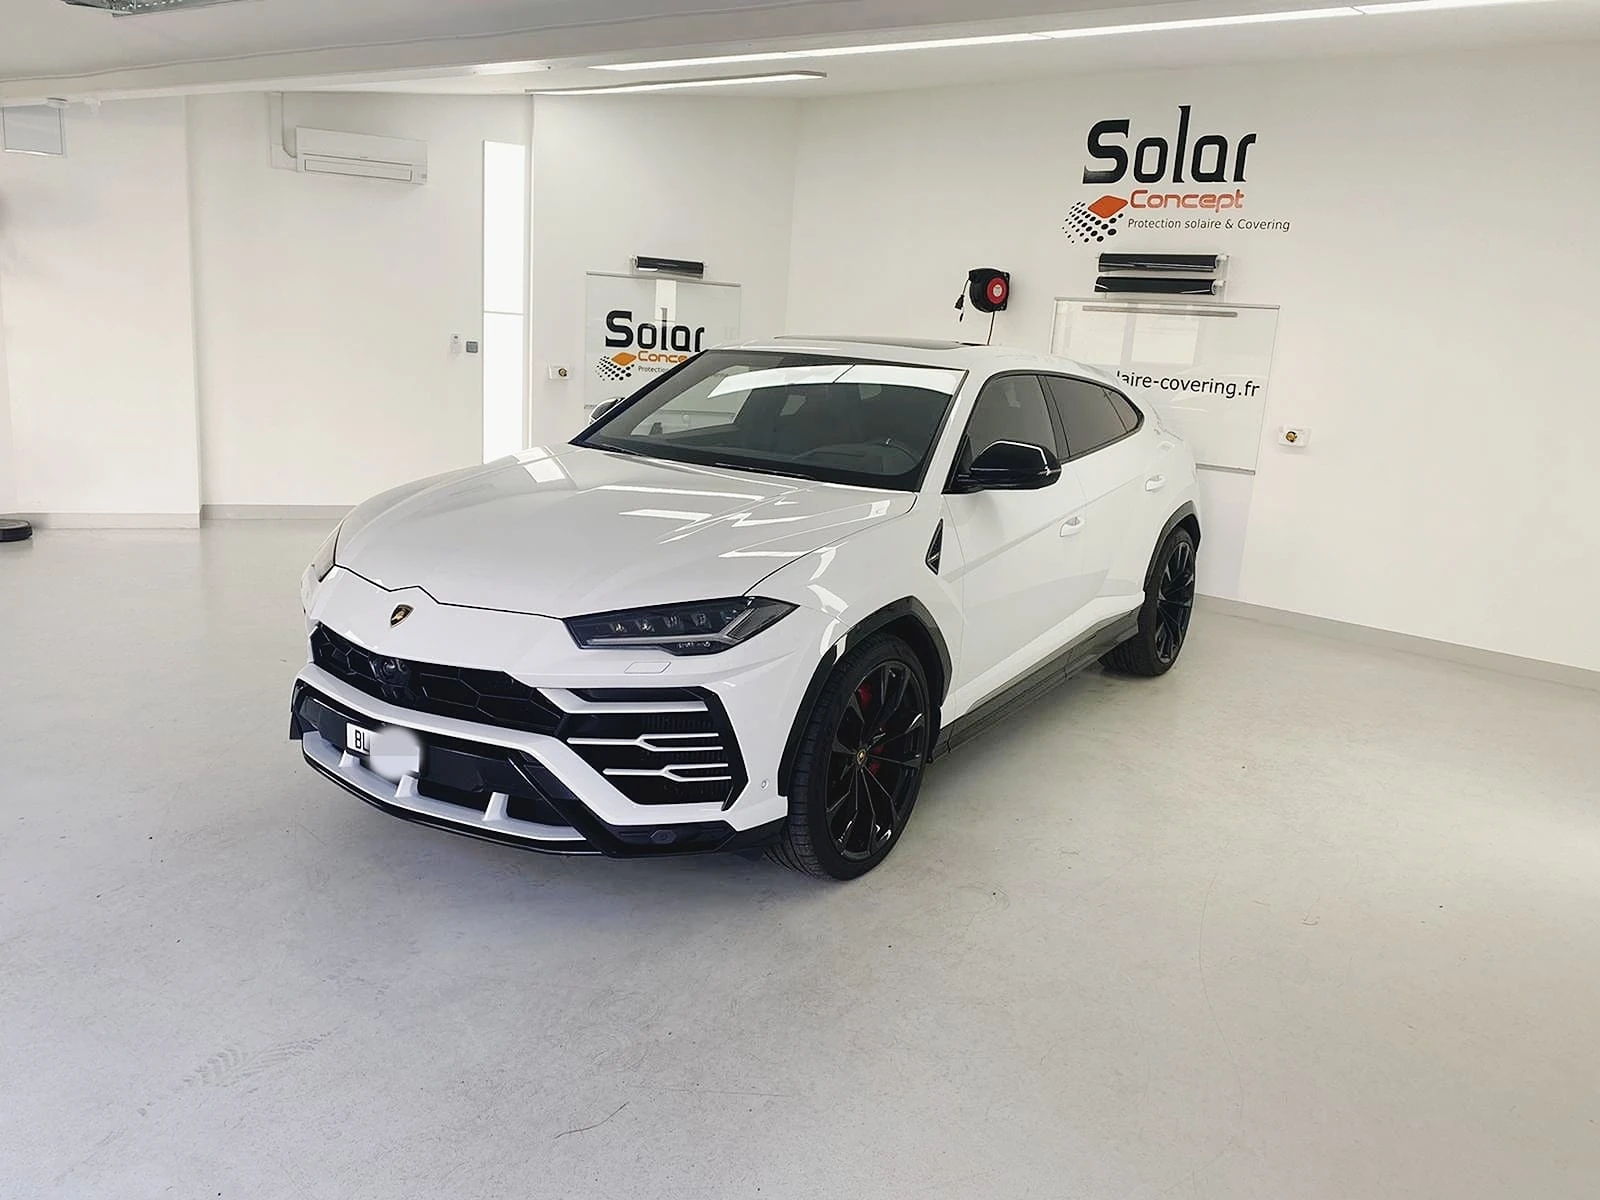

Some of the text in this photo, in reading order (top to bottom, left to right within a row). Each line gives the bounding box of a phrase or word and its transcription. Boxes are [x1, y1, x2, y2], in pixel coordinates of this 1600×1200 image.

[1082, 105, 1257, 184] Solar
[1130, 189, 1245, 213] Concept
[1128, 218, 1290, 232] Protection solaire & Covering
[605, 307, 705, 352] Solar
[638, 350, 688, 363] Conce
